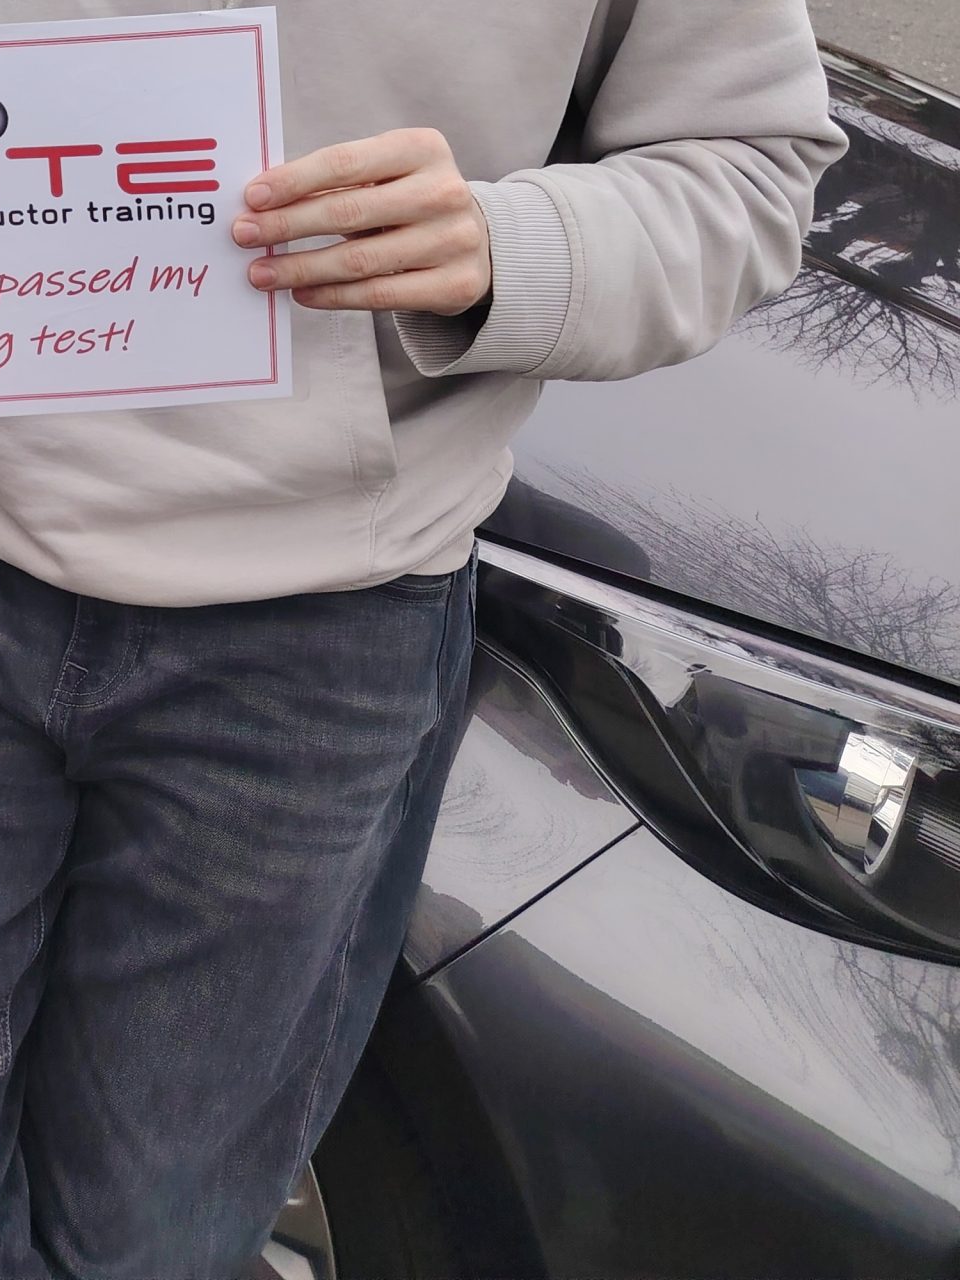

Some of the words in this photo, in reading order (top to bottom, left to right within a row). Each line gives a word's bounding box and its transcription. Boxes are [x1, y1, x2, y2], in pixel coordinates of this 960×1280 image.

[88, 197, 216, 225] training
[149, 263, 208, 297] my
[29, 320, 135, 356] test!
